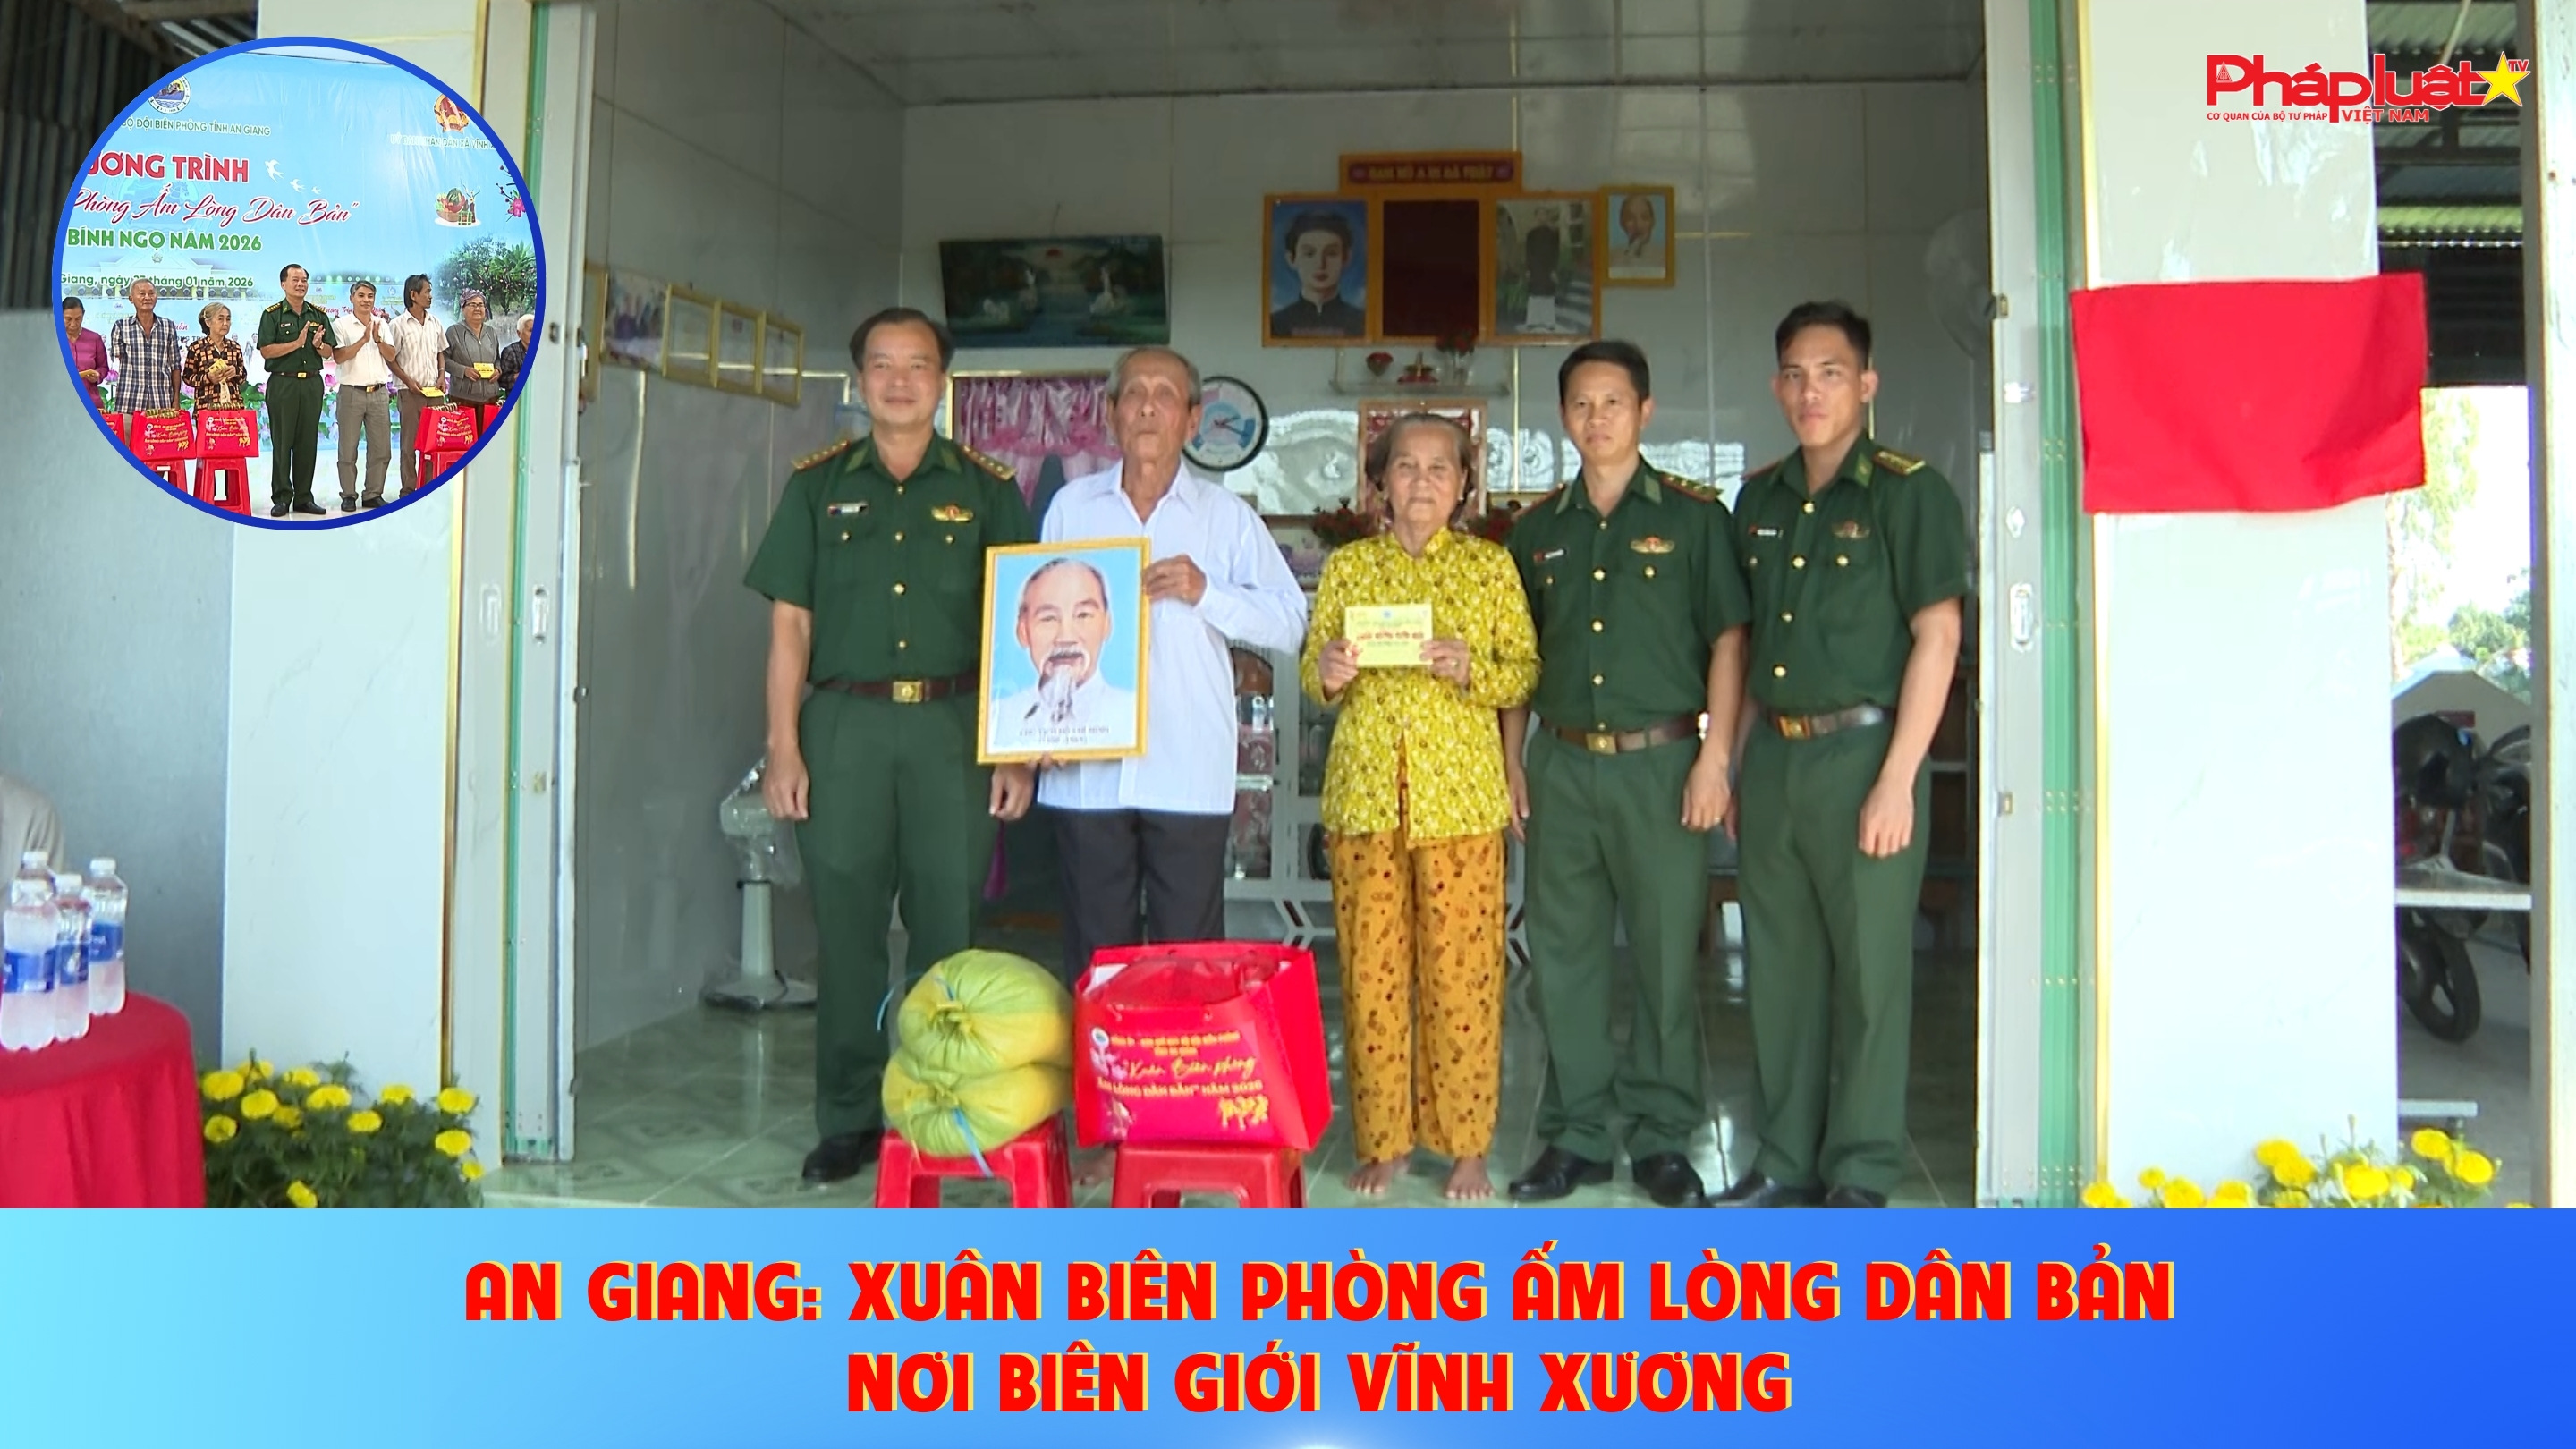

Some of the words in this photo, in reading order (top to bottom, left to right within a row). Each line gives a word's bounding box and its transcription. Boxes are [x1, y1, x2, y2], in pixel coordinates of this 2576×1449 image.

[136, 117, 153, 131] ĐỘI
[155, 116, 174, 130] BIÊN
[176, 119, 207, 131] PHÒNG
[230, 124, 242, 133] AN
[243, 125, 270, 135] GIANG
[472, 138, 488, 148] VĨNH
[173, 153, 249, 182] TRÌNH
[131, 183, 180, 219] Ấm
[182, 195, 237, 228] Lòng
[242, 197, 294, 223] Dân
[68, 226, 114, 247] BÍNH
[120, 231, 165, 250] NGỌ
[170, 229, 215, 250] NĂM
[218, 234, 262, 251] 2026
[101, 275, 131, 287] ngày
[185, 276, 198, 286] 01
[201, 276, 225, 286] năm
[228, 276, 254, 287] 2026
